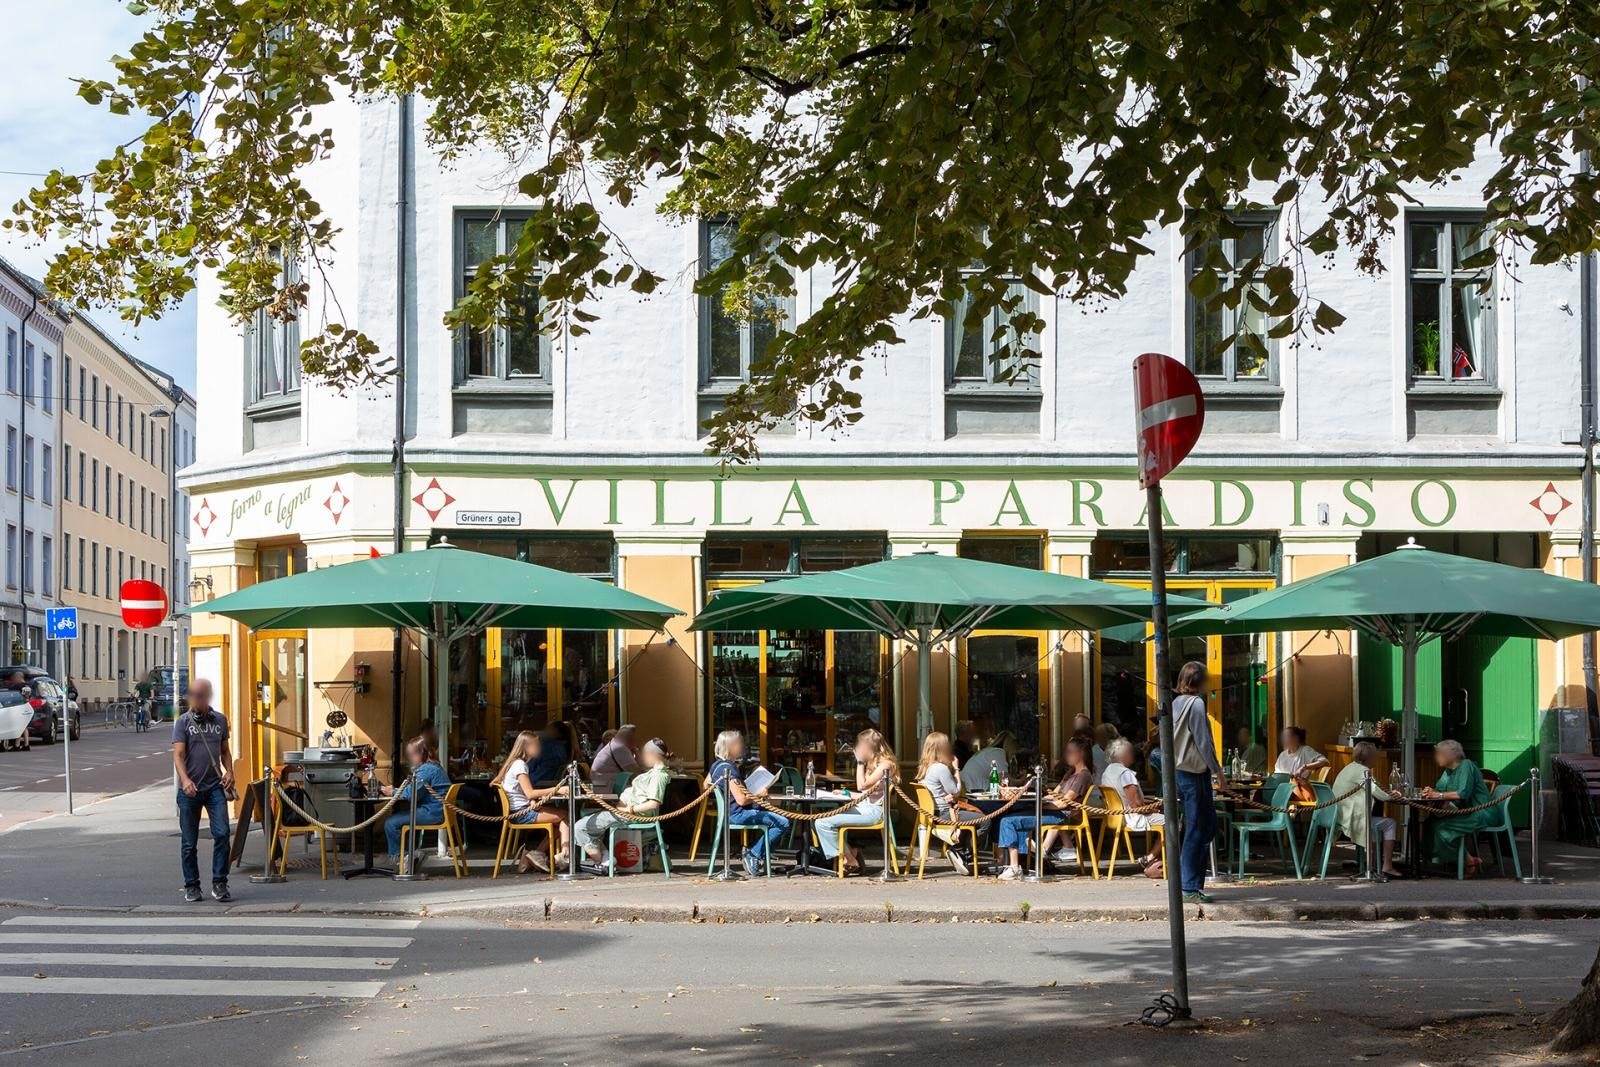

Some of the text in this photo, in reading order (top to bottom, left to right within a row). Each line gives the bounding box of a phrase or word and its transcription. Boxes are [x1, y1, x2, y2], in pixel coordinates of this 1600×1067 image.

[226, 484, 312, 538] forno a legna
[460, 512, 516, 525] Grüners gate
[534, 478, 1457, 528] VILLA PARADISO
